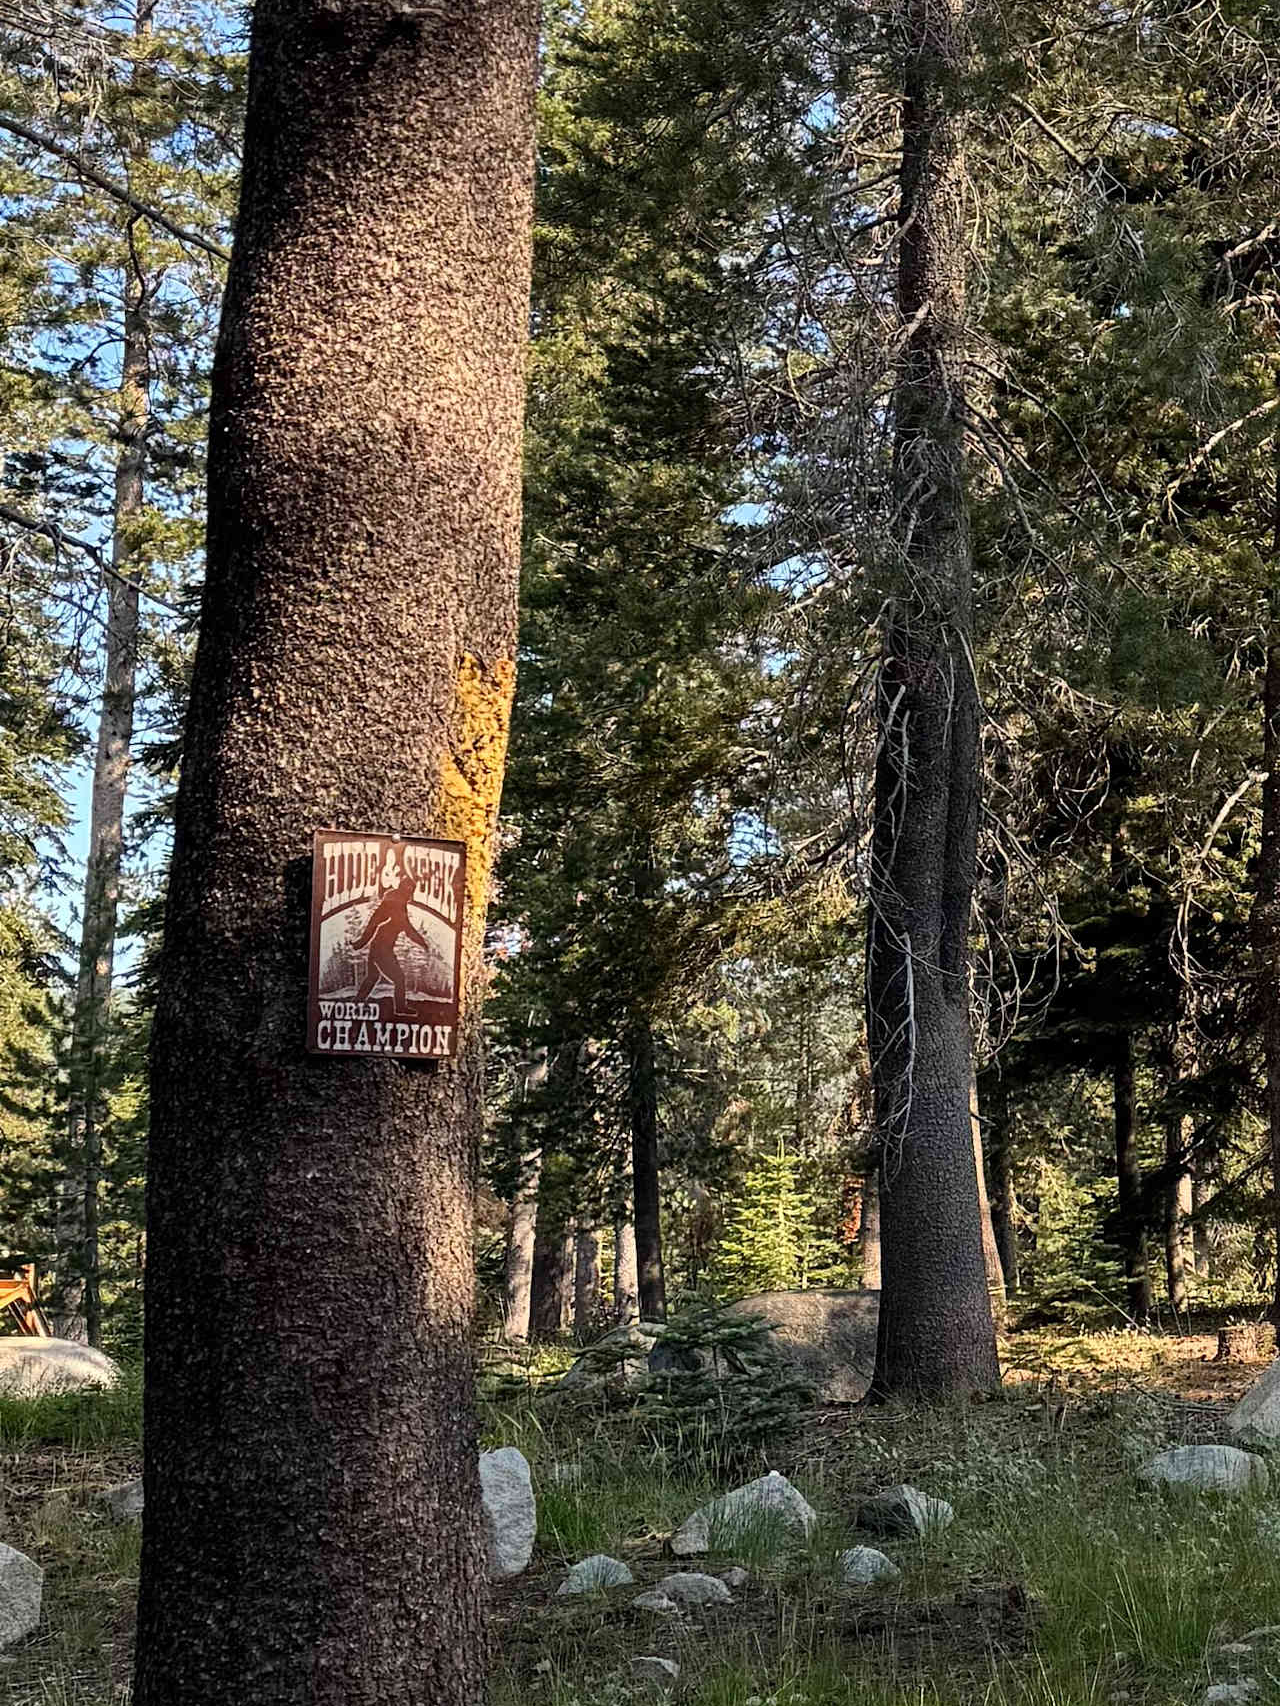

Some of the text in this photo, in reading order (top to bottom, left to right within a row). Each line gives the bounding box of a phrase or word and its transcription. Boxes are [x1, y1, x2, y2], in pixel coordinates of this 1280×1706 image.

[321, 841, 460, 923] HIDE & SEEK
[319, 1001, 380, 1021] WORLD
[317, 1020, 452, 1056] CHAMPION
